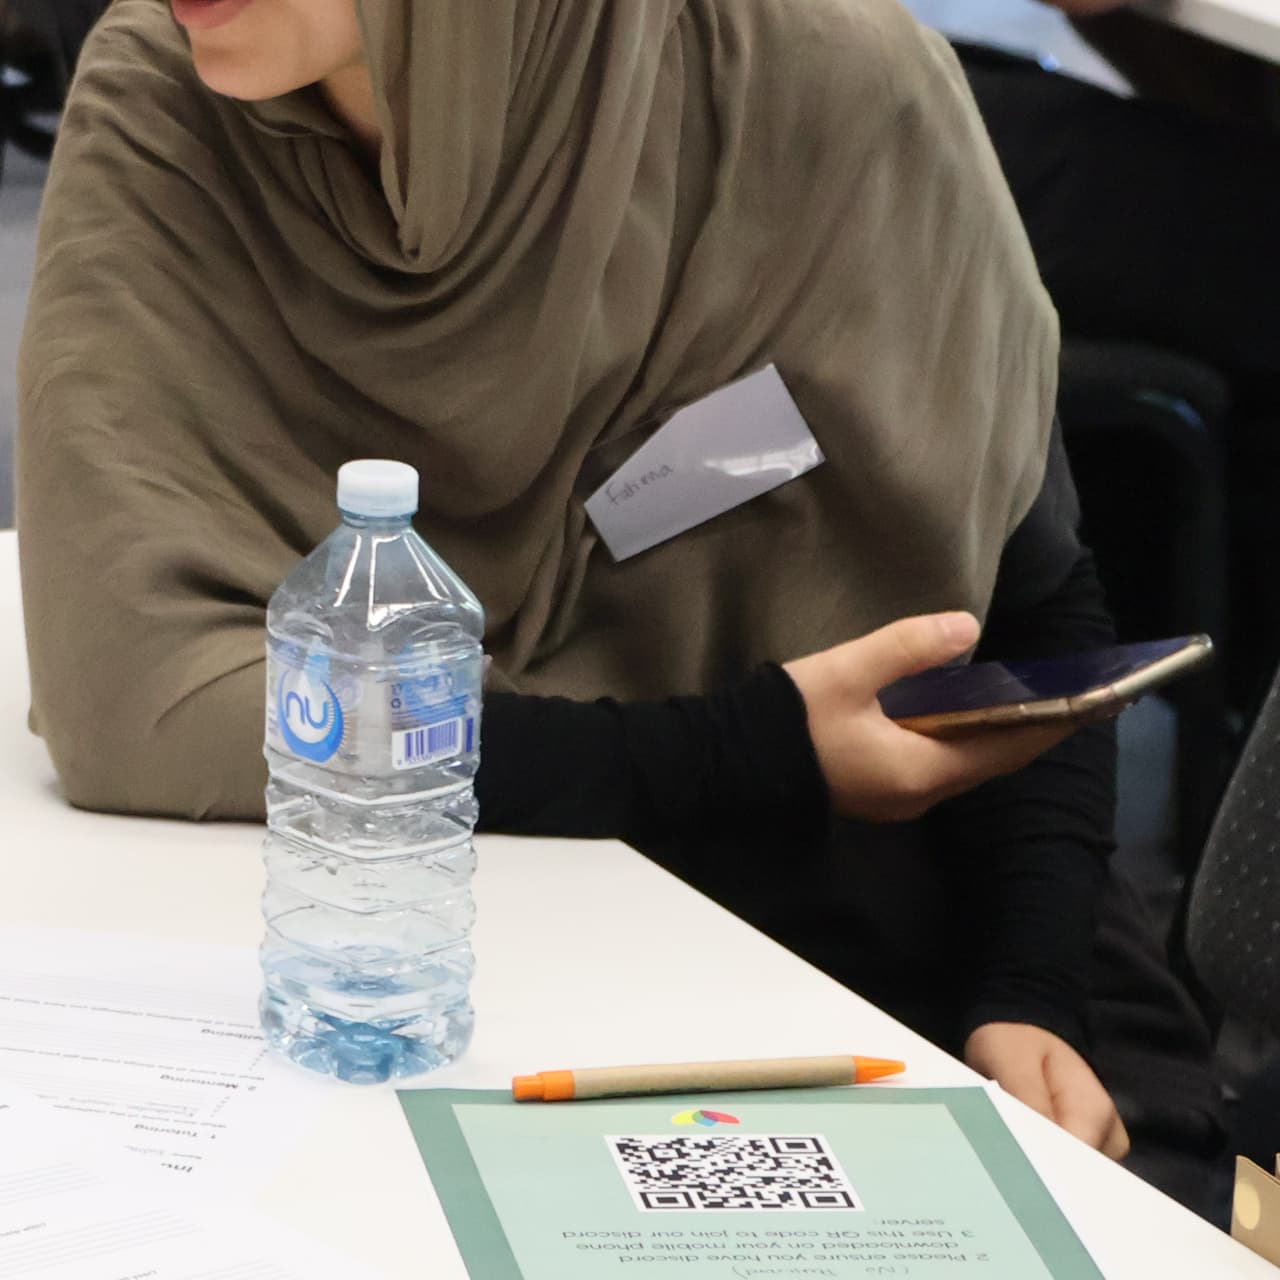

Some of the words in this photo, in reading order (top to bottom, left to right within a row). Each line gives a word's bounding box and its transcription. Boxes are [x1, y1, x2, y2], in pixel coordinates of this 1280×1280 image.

[690, 1230, 729, 1238] join
[866, 1230, 905, 1238] this
[575, 1242, 645, 1250] phone
[617, 1255, 700, 1263] discord
[766, 1253, 808, 1261] you
[893, 1253, 968, 1261] Please
